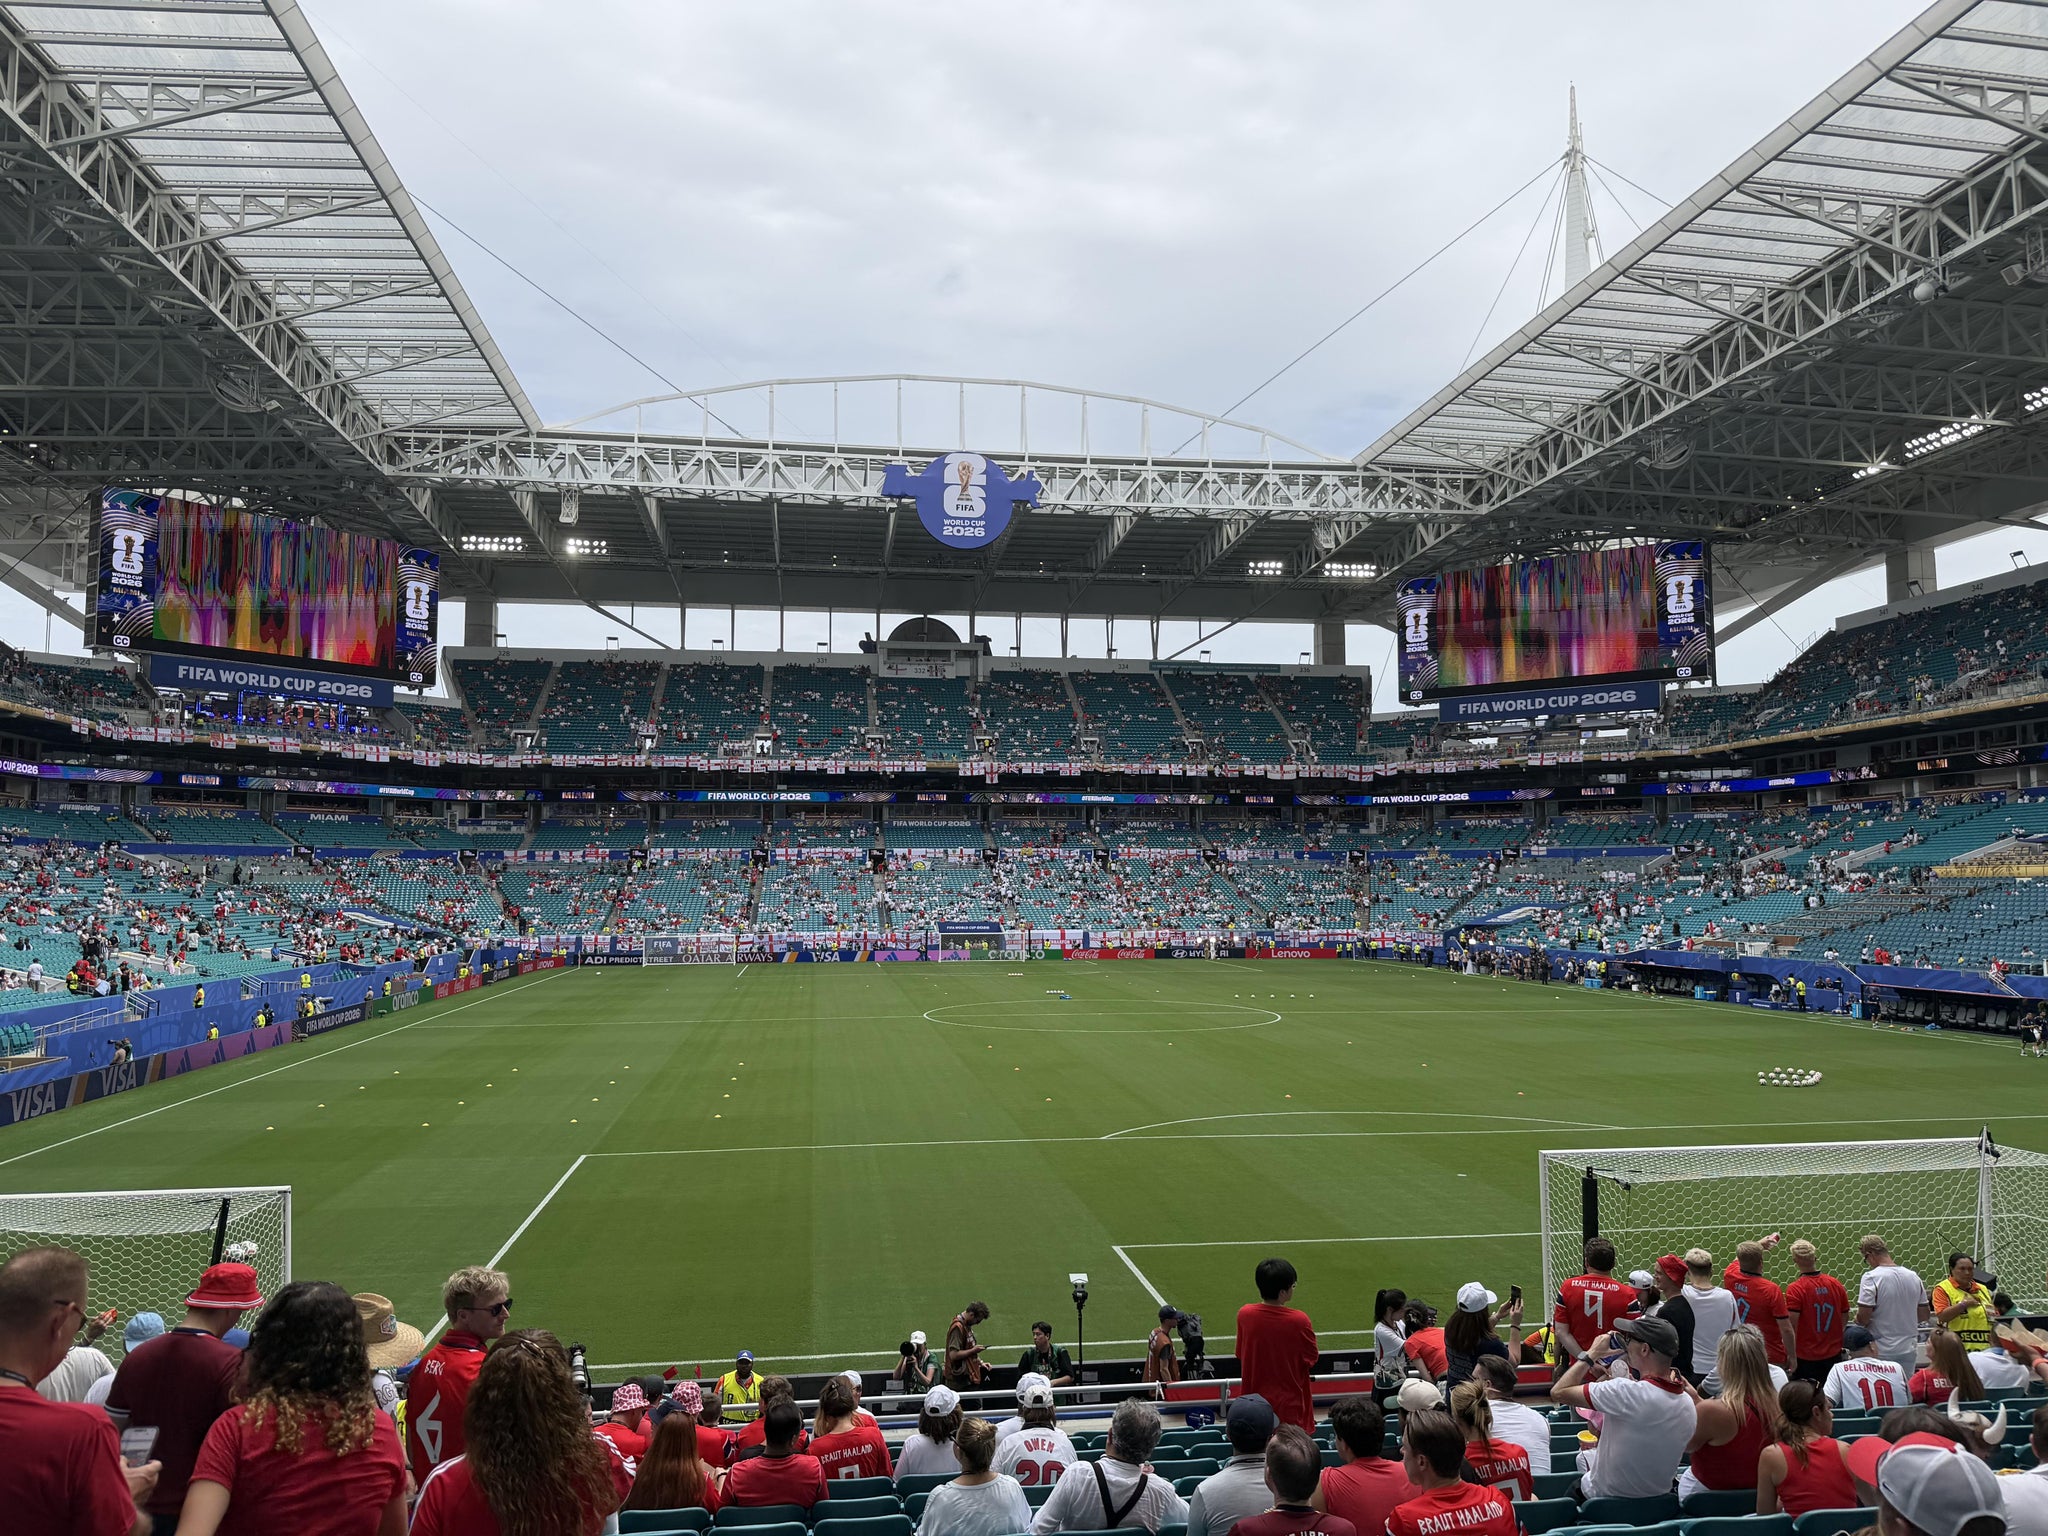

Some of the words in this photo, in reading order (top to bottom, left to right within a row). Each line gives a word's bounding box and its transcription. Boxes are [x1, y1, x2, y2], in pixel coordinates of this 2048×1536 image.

[956, 504, 975, 512] FIFA
[971, 520, 985, 528] CUP
[943, 527, 985, 537] 2026
[121, 563, 135, 571] FIFA
[112, 572, 133, 581] WORLD
[133, 574, 143, 582] CUP
[111, 578, 143, 588] 2026
[1971, 583, 1984, 592] 342
[1878, 608, 1889, 616] 341
[1667, 616, 1694, 625] 2026
[405, 621, 429, 631] 2026
[115, 636, 128, 646] CC
[1405, 645, 1428, 653] 2026
[74, 657, 91, 666] 324
[1678, 667, 1690, 676] CC
[178, 665, 217, 682] FIFA
[219, 669, 281, 689] WORLD
[283, 676, 316, 692] CUP
[318, 680, 374, 698] 2026
[412, 673, 422, 682] CC
[1410, 691, 1421, 699] CC
[1458, 699, 1490, 715] FIFA
[1491, 696, 1546, 712] WORLD
[1547, 695, 1579, 707] CUP
[1581, 690, 1637, 706] 2026
[3, 762, 17, 771] CUP
[17, 763, 39, 774] 2026
[1917, 758, 1948, 770] MIAMI
[183, 774, 221, 785] MIAMI
[379, 787, 415, 796] #FIFAWorldCup
[562, 791, 594, 799] MIAMI
[708, 792, 726, 800] FIFA
[727, 792, 760, 800] WORLD
[761, 792, 780, 800] CUP
[780, 792, 811, 800] 2026
[1581, 786, 1615, 796] MIAMI
[917, 793, 947, 801] MIAMI
[1372, 796, 1389, 804] FIFA
[1390, 795, 1420, 803] WORLD
[1421, 794, 1438, 802] CUP
[1438, 793, 1469, 801] 2026
[60, 803, 101, 812] #FIFAWorldCup
[1832, 802, 1863, 812] MIAMI
[310, 813, 349, 822] MIAMI
[653, 941, 672, 949] FIFA
[1189, 949, 1229, 957] HYUAI
[1271, 949, 1310, 958] Lenovo
[585, 956, 607, 964] ADI
[682, 955, 721, 964] QATAR
[726, 953, 773, 963] ARWAYS
[393, 991, 419, 1011] aramco
[306, 1019, 318, 1032] FIFA
[318, 1016, 336, 1030] WORLD
[336, 1013, 344, 1026] CUP
[344, 1008, 361, 1022] 2026
[99, 1061, 137, 1096] VISA
[8, 1080, 56, 1122] VISA
[1591, 1281, 1619, 1292] HAALAND
[1584, 1289, 1604, 1329] 9
[1737, 1297, 1750, 1324] 7
[1813, 1302, 1834, 1333] 17
[424, 1359, 446, 1376] BERG
[1843, 1362, 1897, 1375] BELLINGHAM
[1857, 1378, 1894, 1411] 10
[416, 1390, 442, 1464] 6
[1023, 1438, 1055, 1454] OWEN
[821, 1449, 842, 1465] BRAUT
[842, 1444, 873, 1459] HAALAND
[1417, 1512, 1456, 1536] BRAUT
[1458, 1500, 1503, 1528] HAALAND
